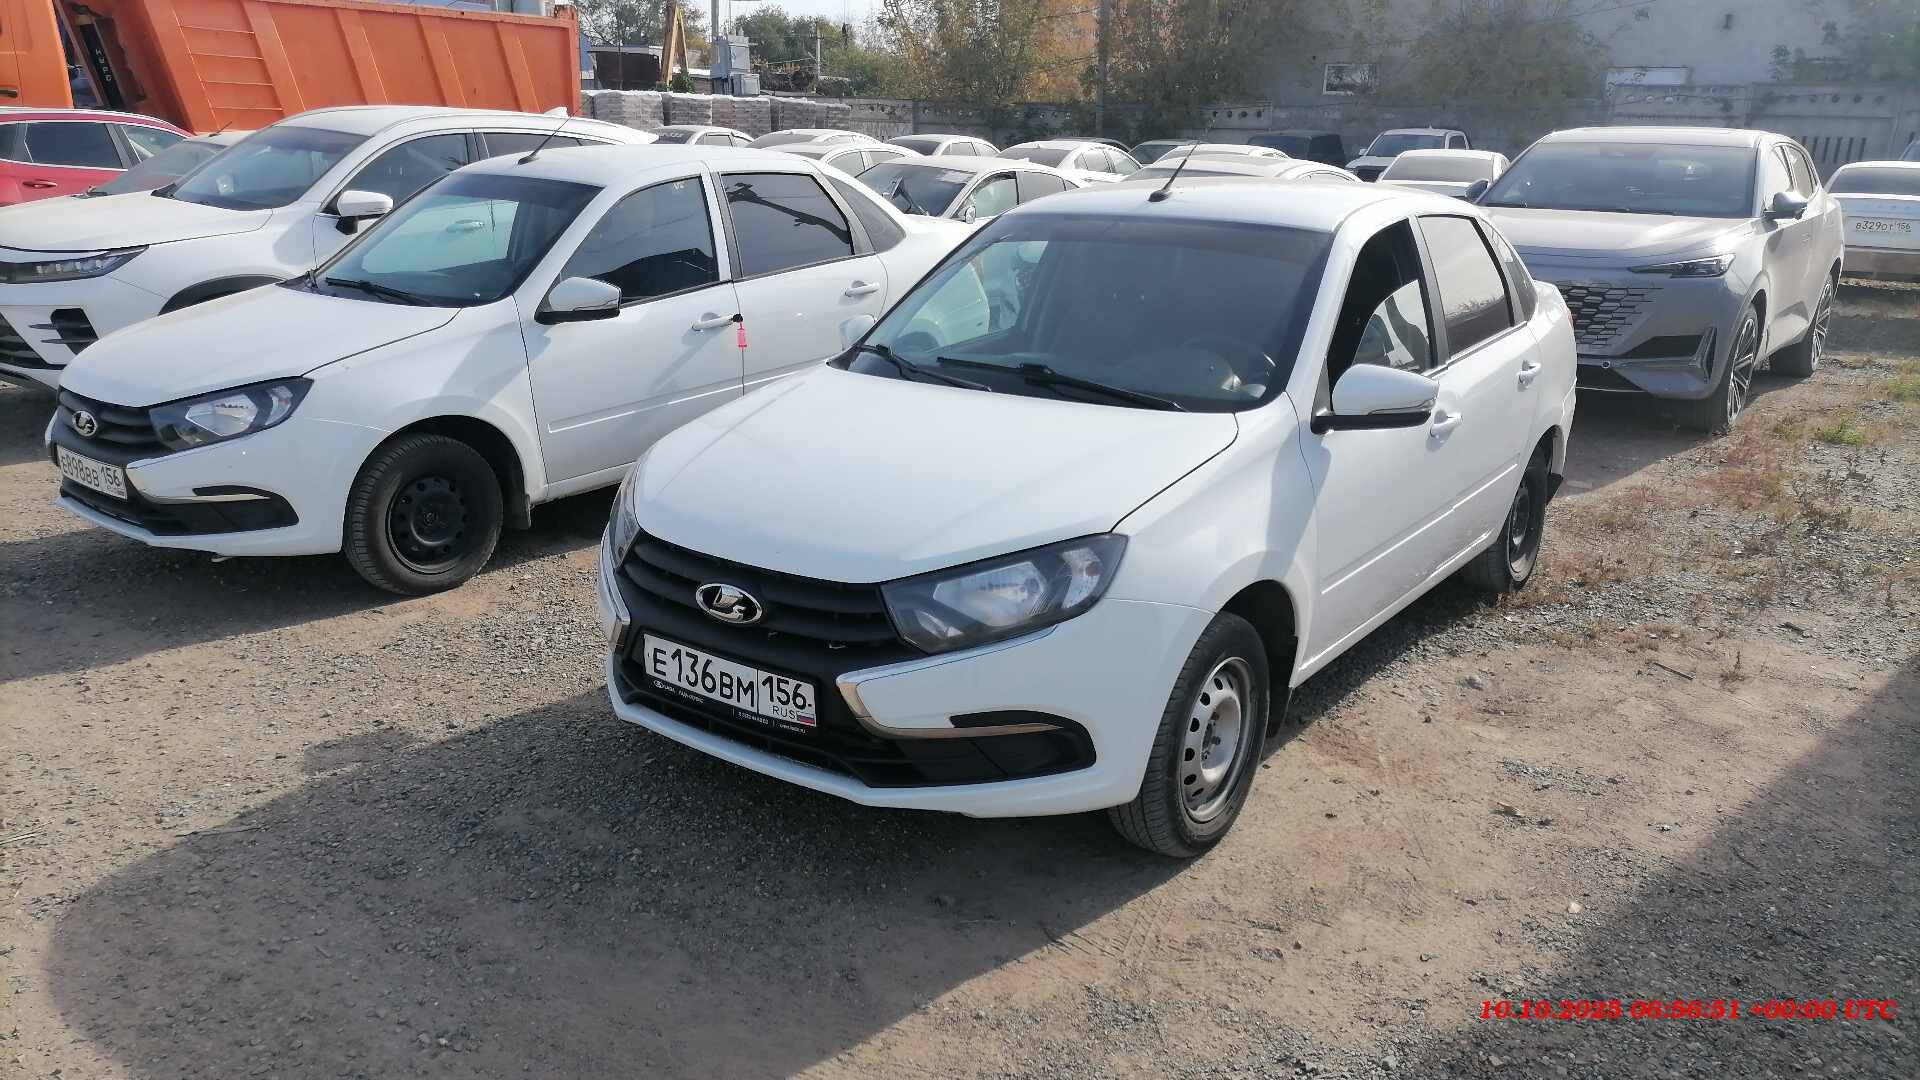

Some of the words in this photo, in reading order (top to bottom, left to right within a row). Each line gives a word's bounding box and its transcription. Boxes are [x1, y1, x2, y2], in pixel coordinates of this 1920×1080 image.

[101, 464, 121, 487] 156
[653, 647, 755, 707] Е136ВМ
[761, 675, 807, 711] 156
[772, 705, 796, 720] RUS
